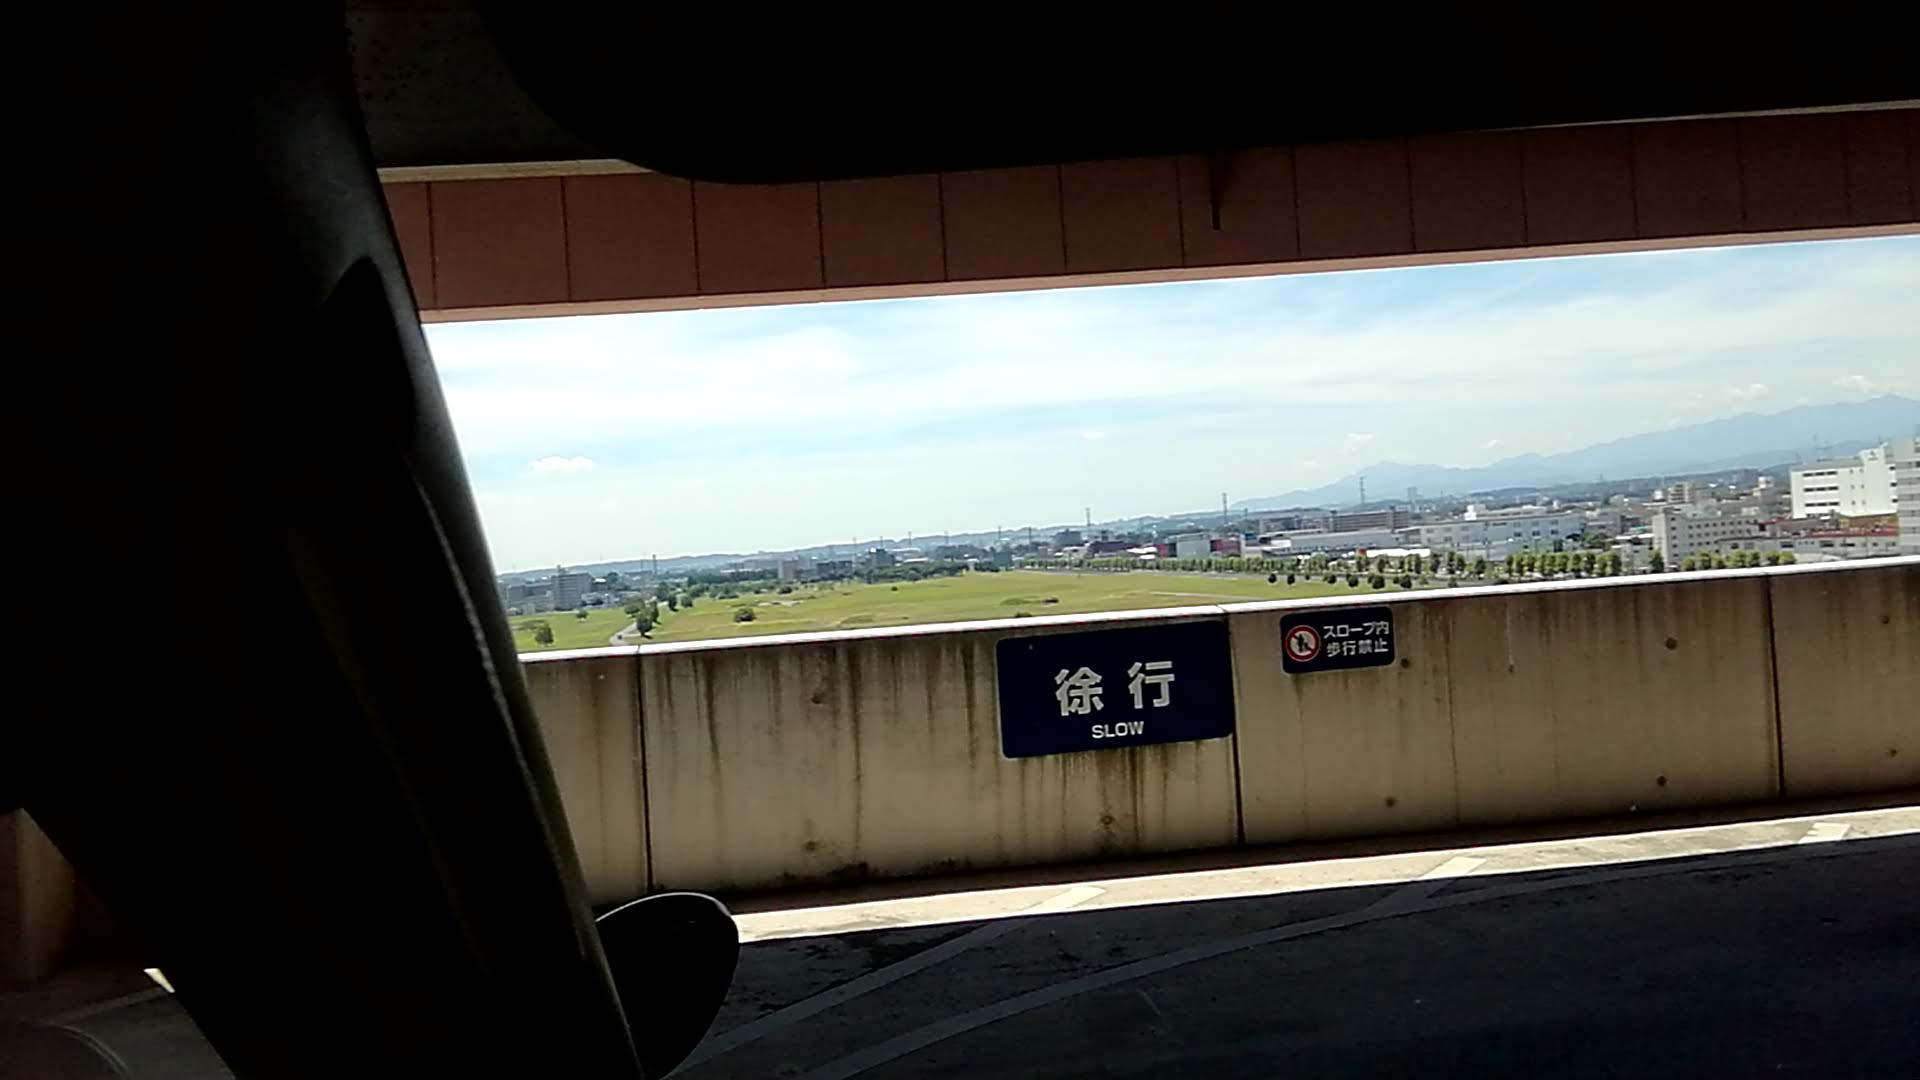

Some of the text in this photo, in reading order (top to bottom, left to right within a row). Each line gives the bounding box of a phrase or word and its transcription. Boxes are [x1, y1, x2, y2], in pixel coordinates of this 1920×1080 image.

[1324, 620, 1389, 639] スロープ内
[1326, 637, 1389, 657] 歩行禁止
[1055, 661, 1175, 716] 徐行
[1091, 721, 1144, 739] SLOW
